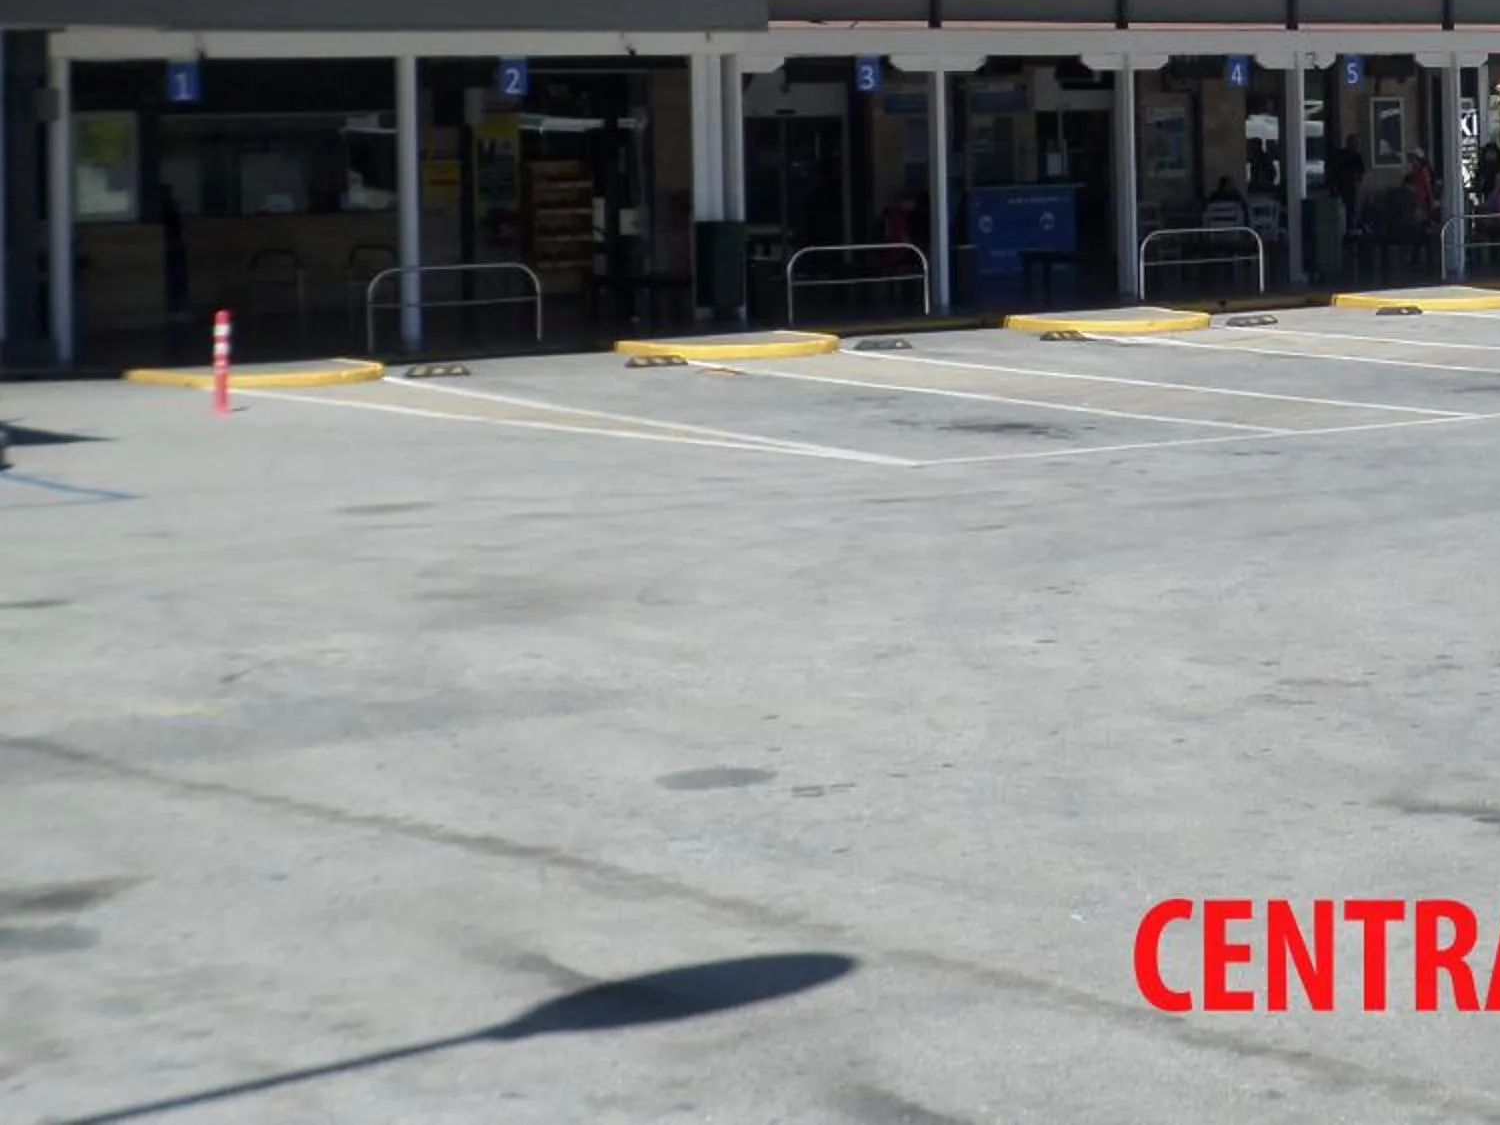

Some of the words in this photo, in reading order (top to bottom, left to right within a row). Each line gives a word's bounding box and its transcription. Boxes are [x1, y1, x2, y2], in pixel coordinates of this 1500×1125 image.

[505, 68, 521, 94] 2
[861, 65, 874, 90] 3
[1231, 62, 1242, 86] 4
[1347, 62, 1358, 84] 5
[174, 73, 192, 100] 1
